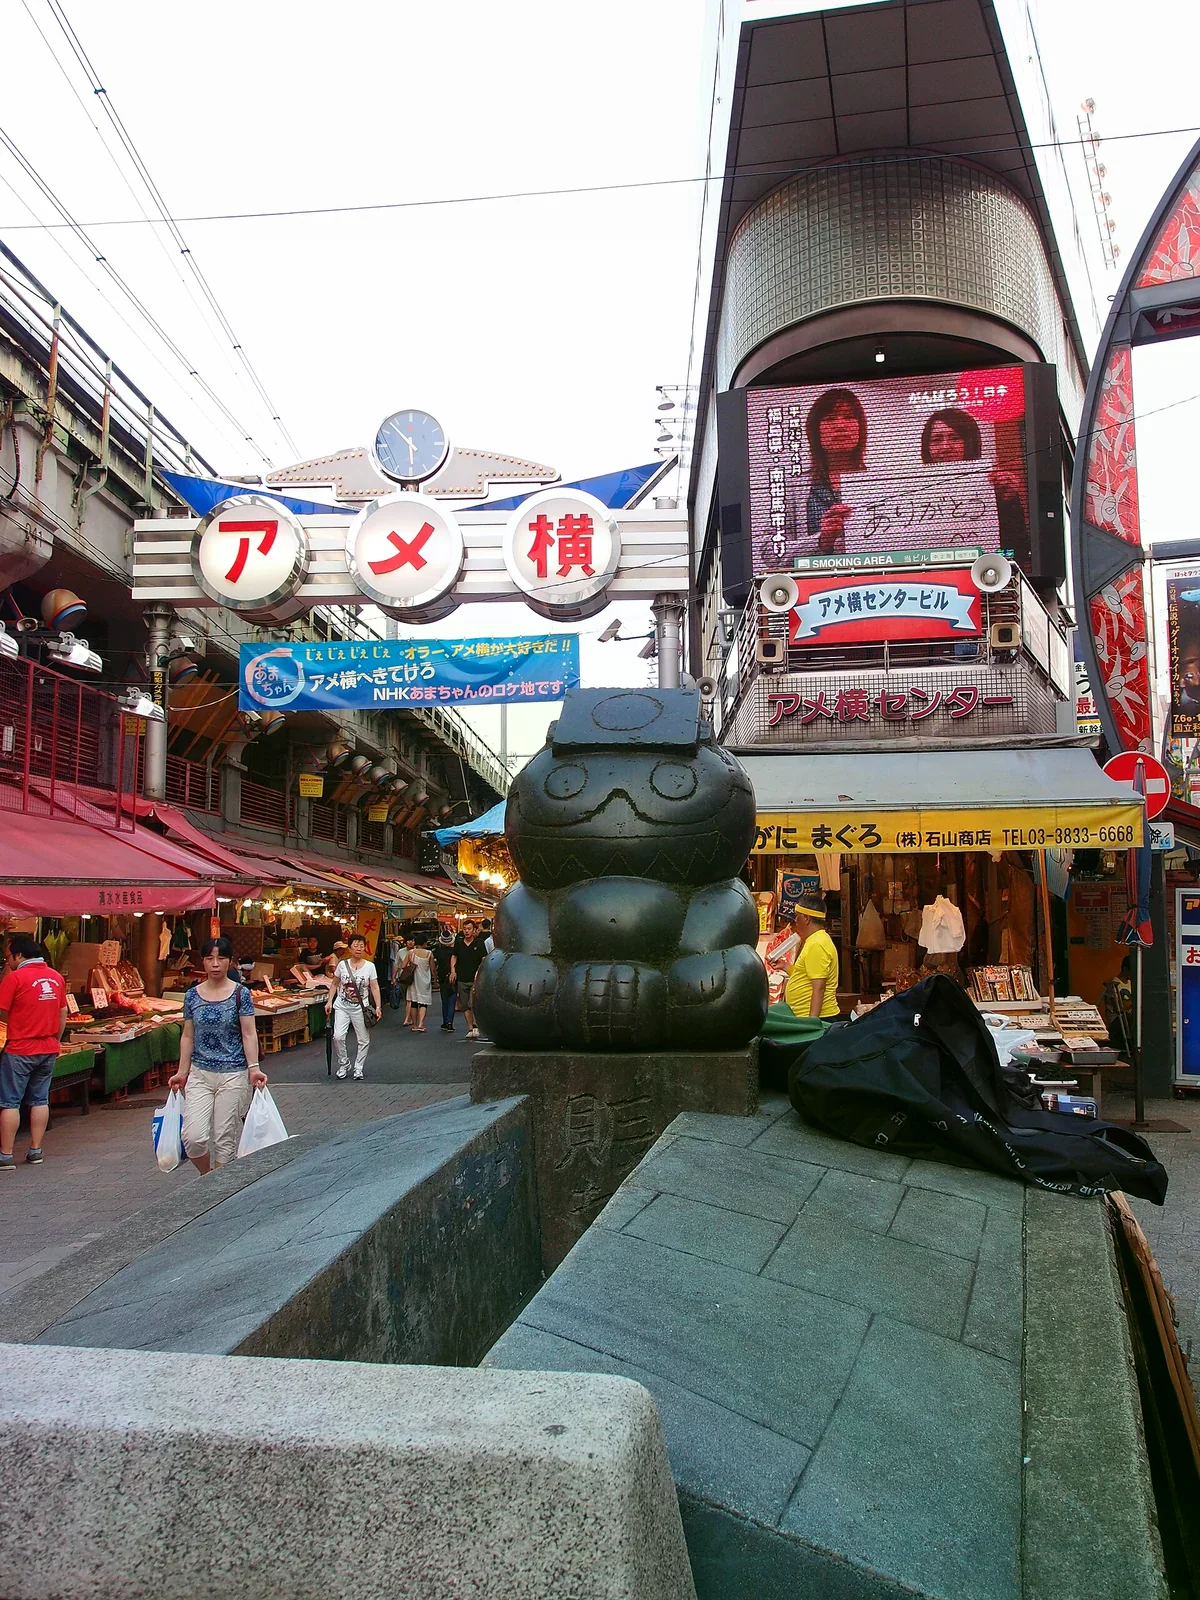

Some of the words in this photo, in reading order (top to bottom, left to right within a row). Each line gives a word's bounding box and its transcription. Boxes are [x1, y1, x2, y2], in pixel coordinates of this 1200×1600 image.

[218, 513, 594, 585] アメ横
[812, 557, 862, 569] SMOKING
[863, 555, 893, 566] AREA
[903, 554, 929, 563] 当ビル
[818, 588, 949, 618] アメ横センタービル
[309, 661, 435, 692] アメ横へきてけろ
[373, 680, 564, 701] NHKあまちゃんのロケ地です
[767, 686, 1013, 727] アメ横センター
[811, 823, 882, 849] まぐろ
[895, 829, 992, 848] (株)石山商店
